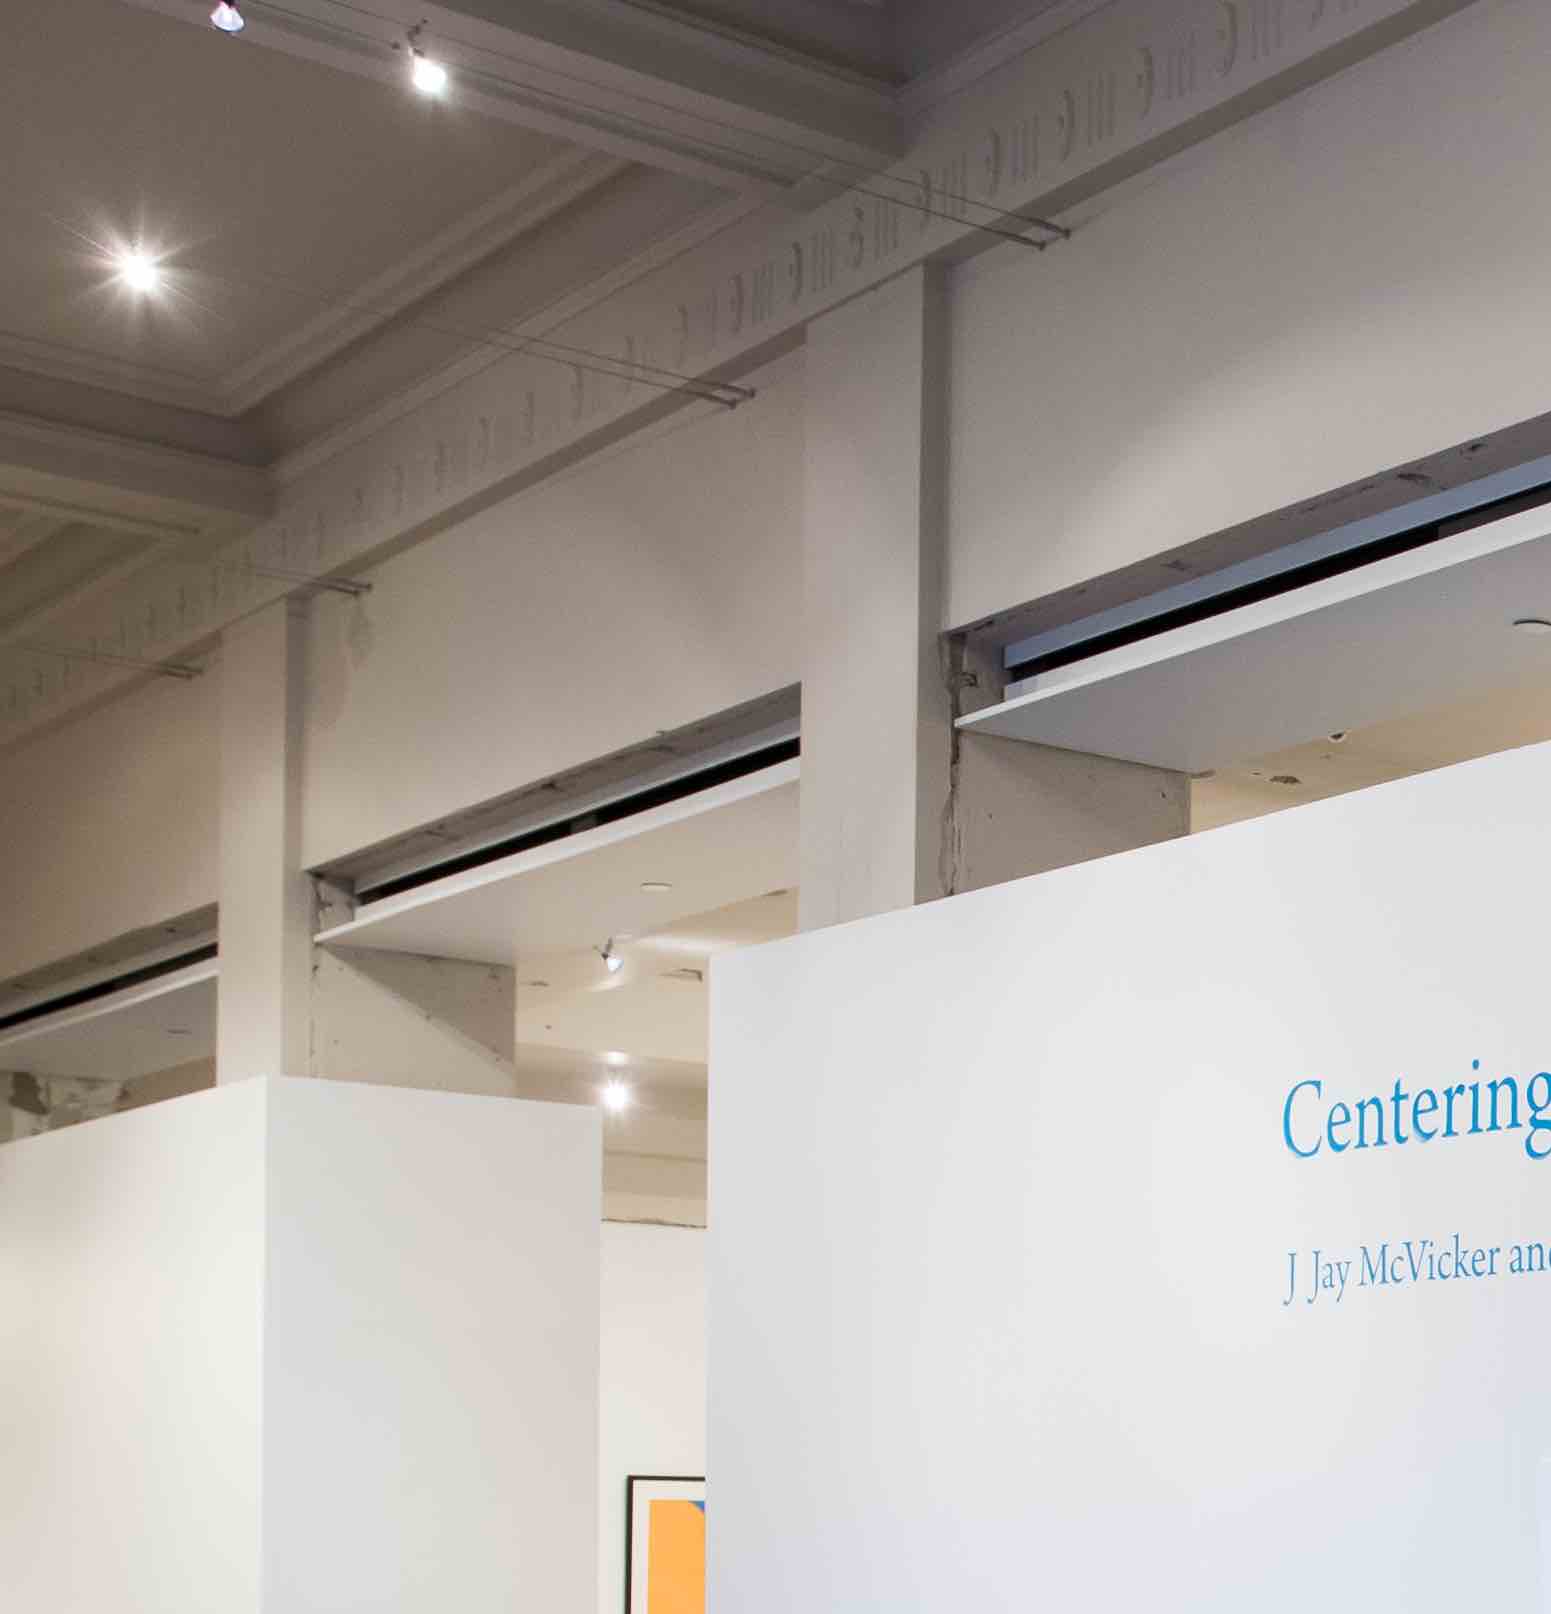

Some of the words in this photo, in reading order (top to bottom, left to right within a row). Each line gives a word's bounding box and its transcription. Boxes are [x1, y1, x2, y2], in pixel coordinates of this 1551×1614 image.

[1282, 1252, 1298, 1306] J
[1306, 1249, 1352, 1305] Jay
[1357, 1232, 1501, 1287] McVicker
